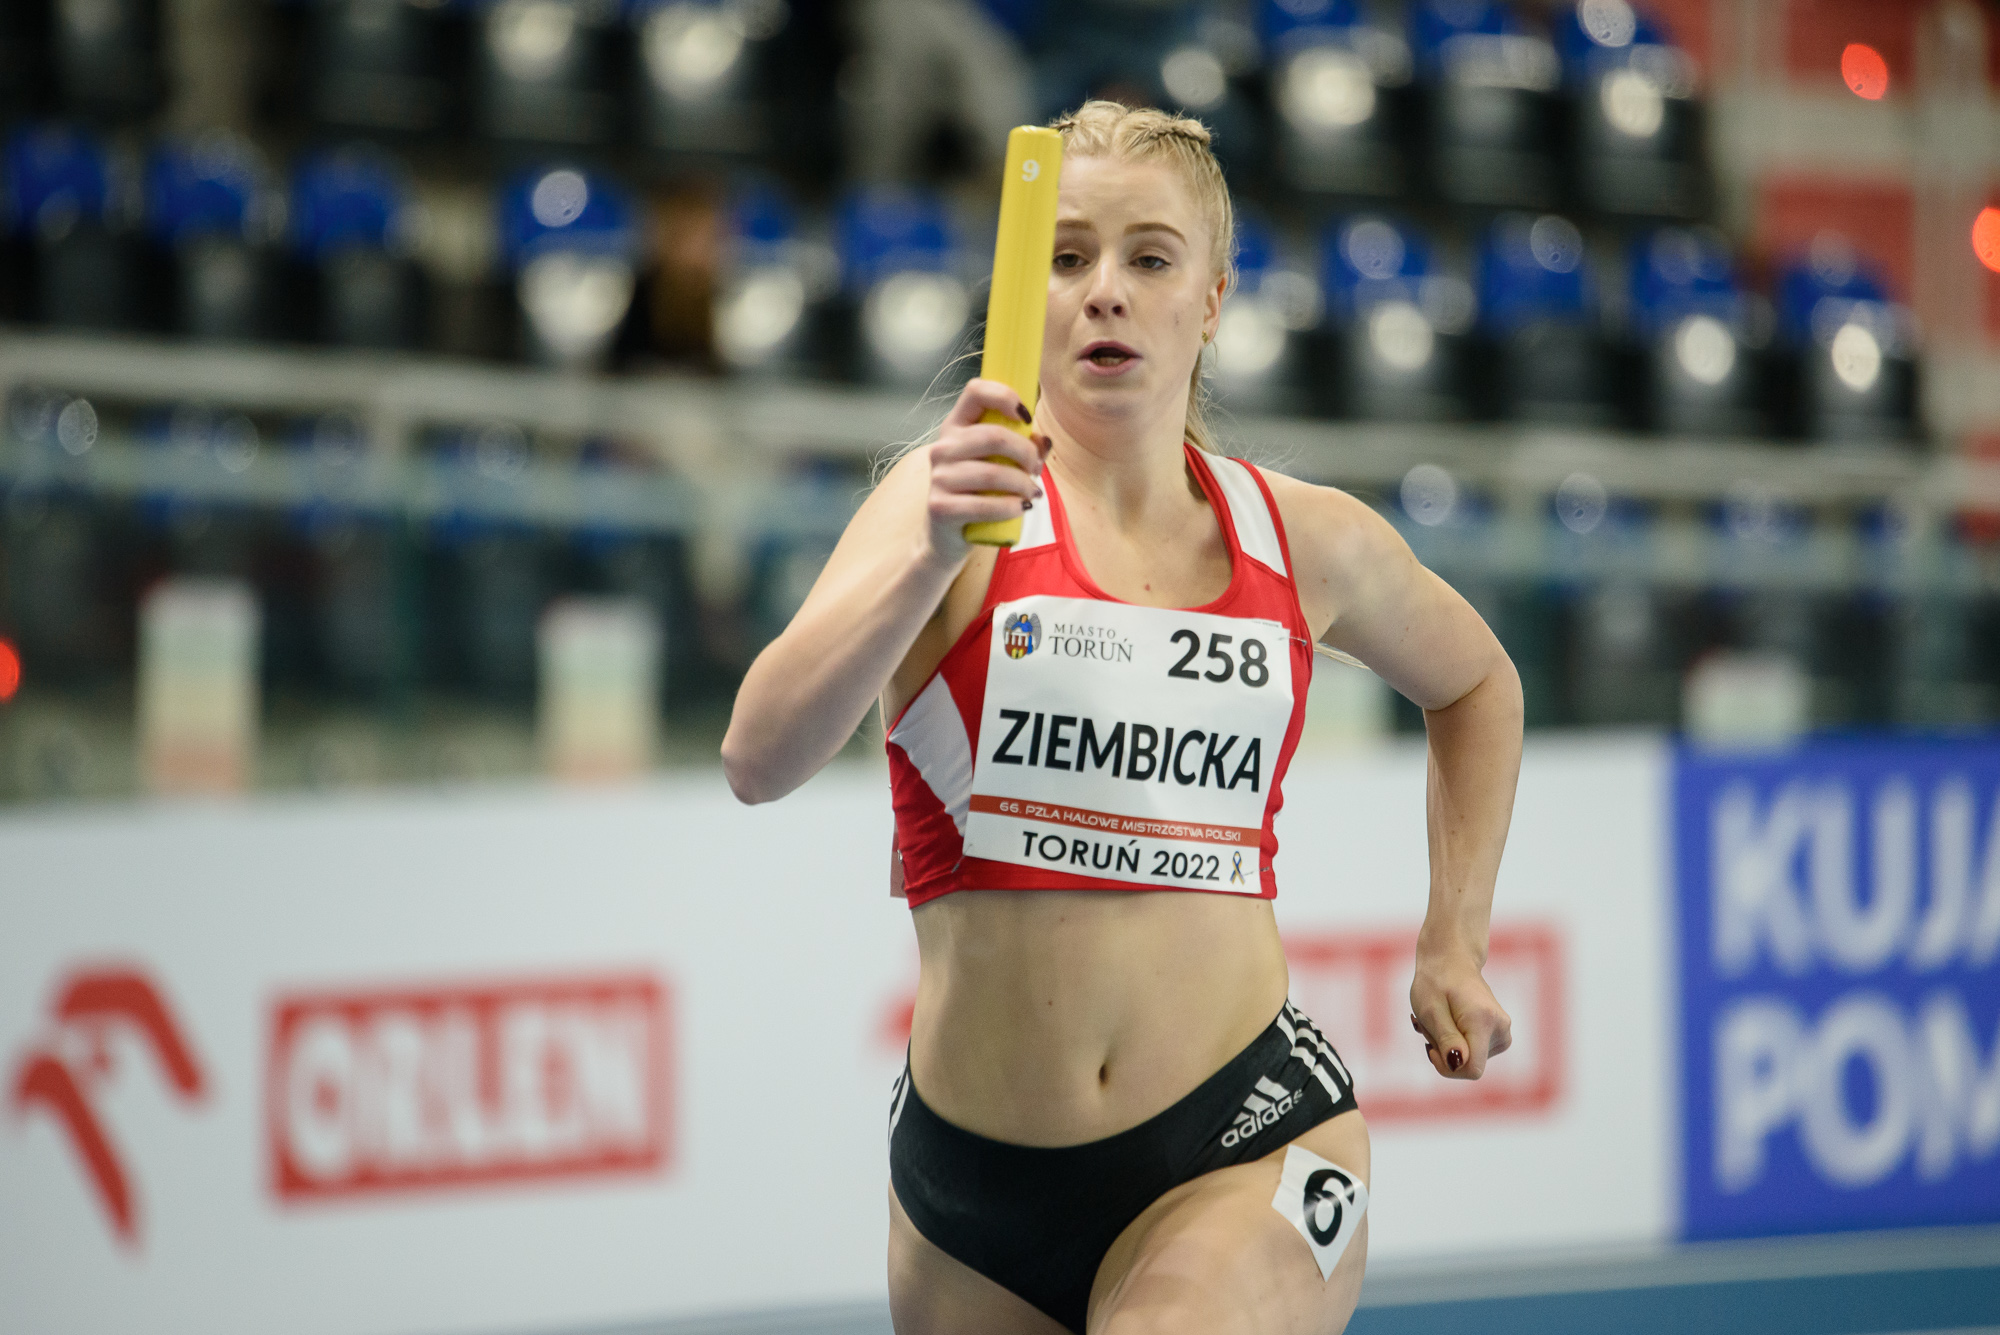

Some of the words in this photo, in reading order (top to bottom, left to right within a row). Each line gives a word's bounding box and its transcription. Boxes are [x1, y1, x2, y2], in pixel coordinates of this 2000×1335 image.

[1021, 159, 1040, 182] 9
[1048, 635, 1134, 663] TORUŃ
[1054, 623, 1116, 640] MIASTO
[1168, 629, 1270, 688] 258
[992, 708, 1262, 793] ZIEMBICKA
[1025, 805, 1060, 820] PZLA
[1063, 811, 1119, 830] HALOWE
[1121, 820, 1204, 839] MISTRZOSTWA
[1205, 828, 1241, 842] POLSKI
[1022, 831, 1140, 874] TORUŃ
[1150, 850, 1220, 881] 2022
[1221, 1088, 1304, 1148] adidas
[1303, 1169, 1356, 1247] 6
